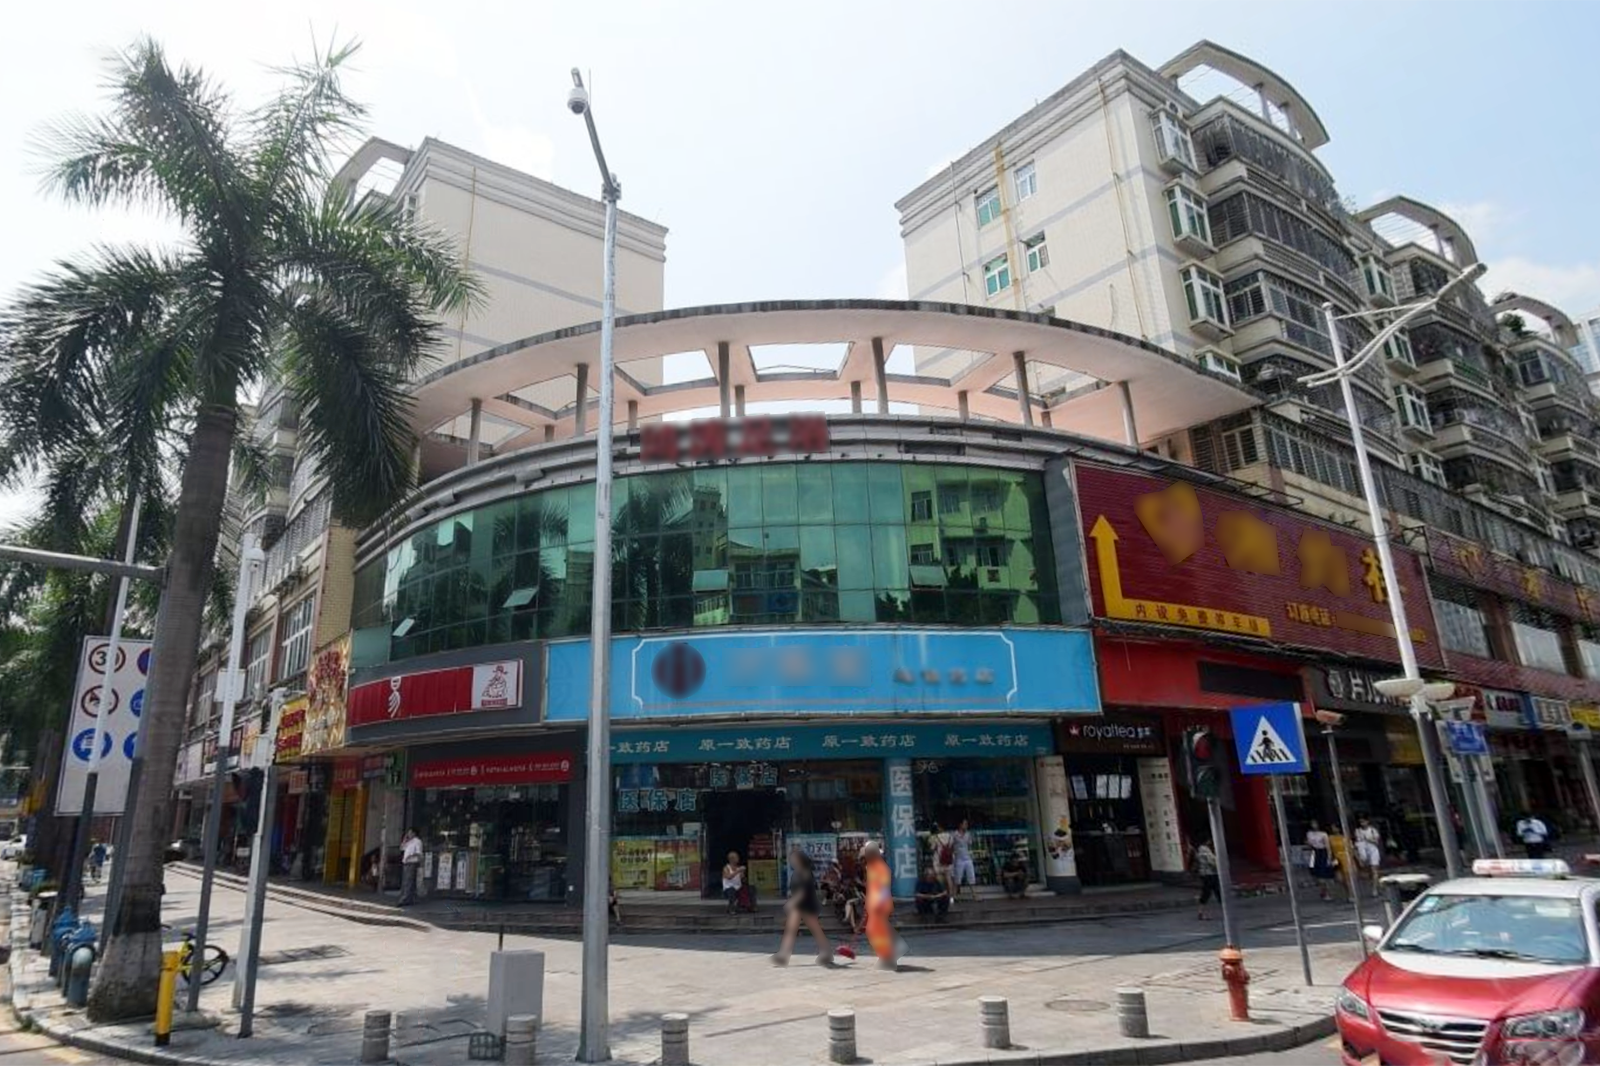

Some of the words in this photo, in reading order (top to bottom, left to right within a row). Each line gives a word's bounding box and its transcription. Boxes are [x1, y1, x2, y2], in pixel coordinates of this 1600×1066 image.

[699, 736, 792, 751] 原一致药店
[822, 734, 917, 748] 原一致药店
[945, 734, 1029, 747] 原一致药店
[1083, 723, 1136, 741] royaltea
[618, 788, 697, 812] 医保店
[889, 765, 918, 879] 医保店
